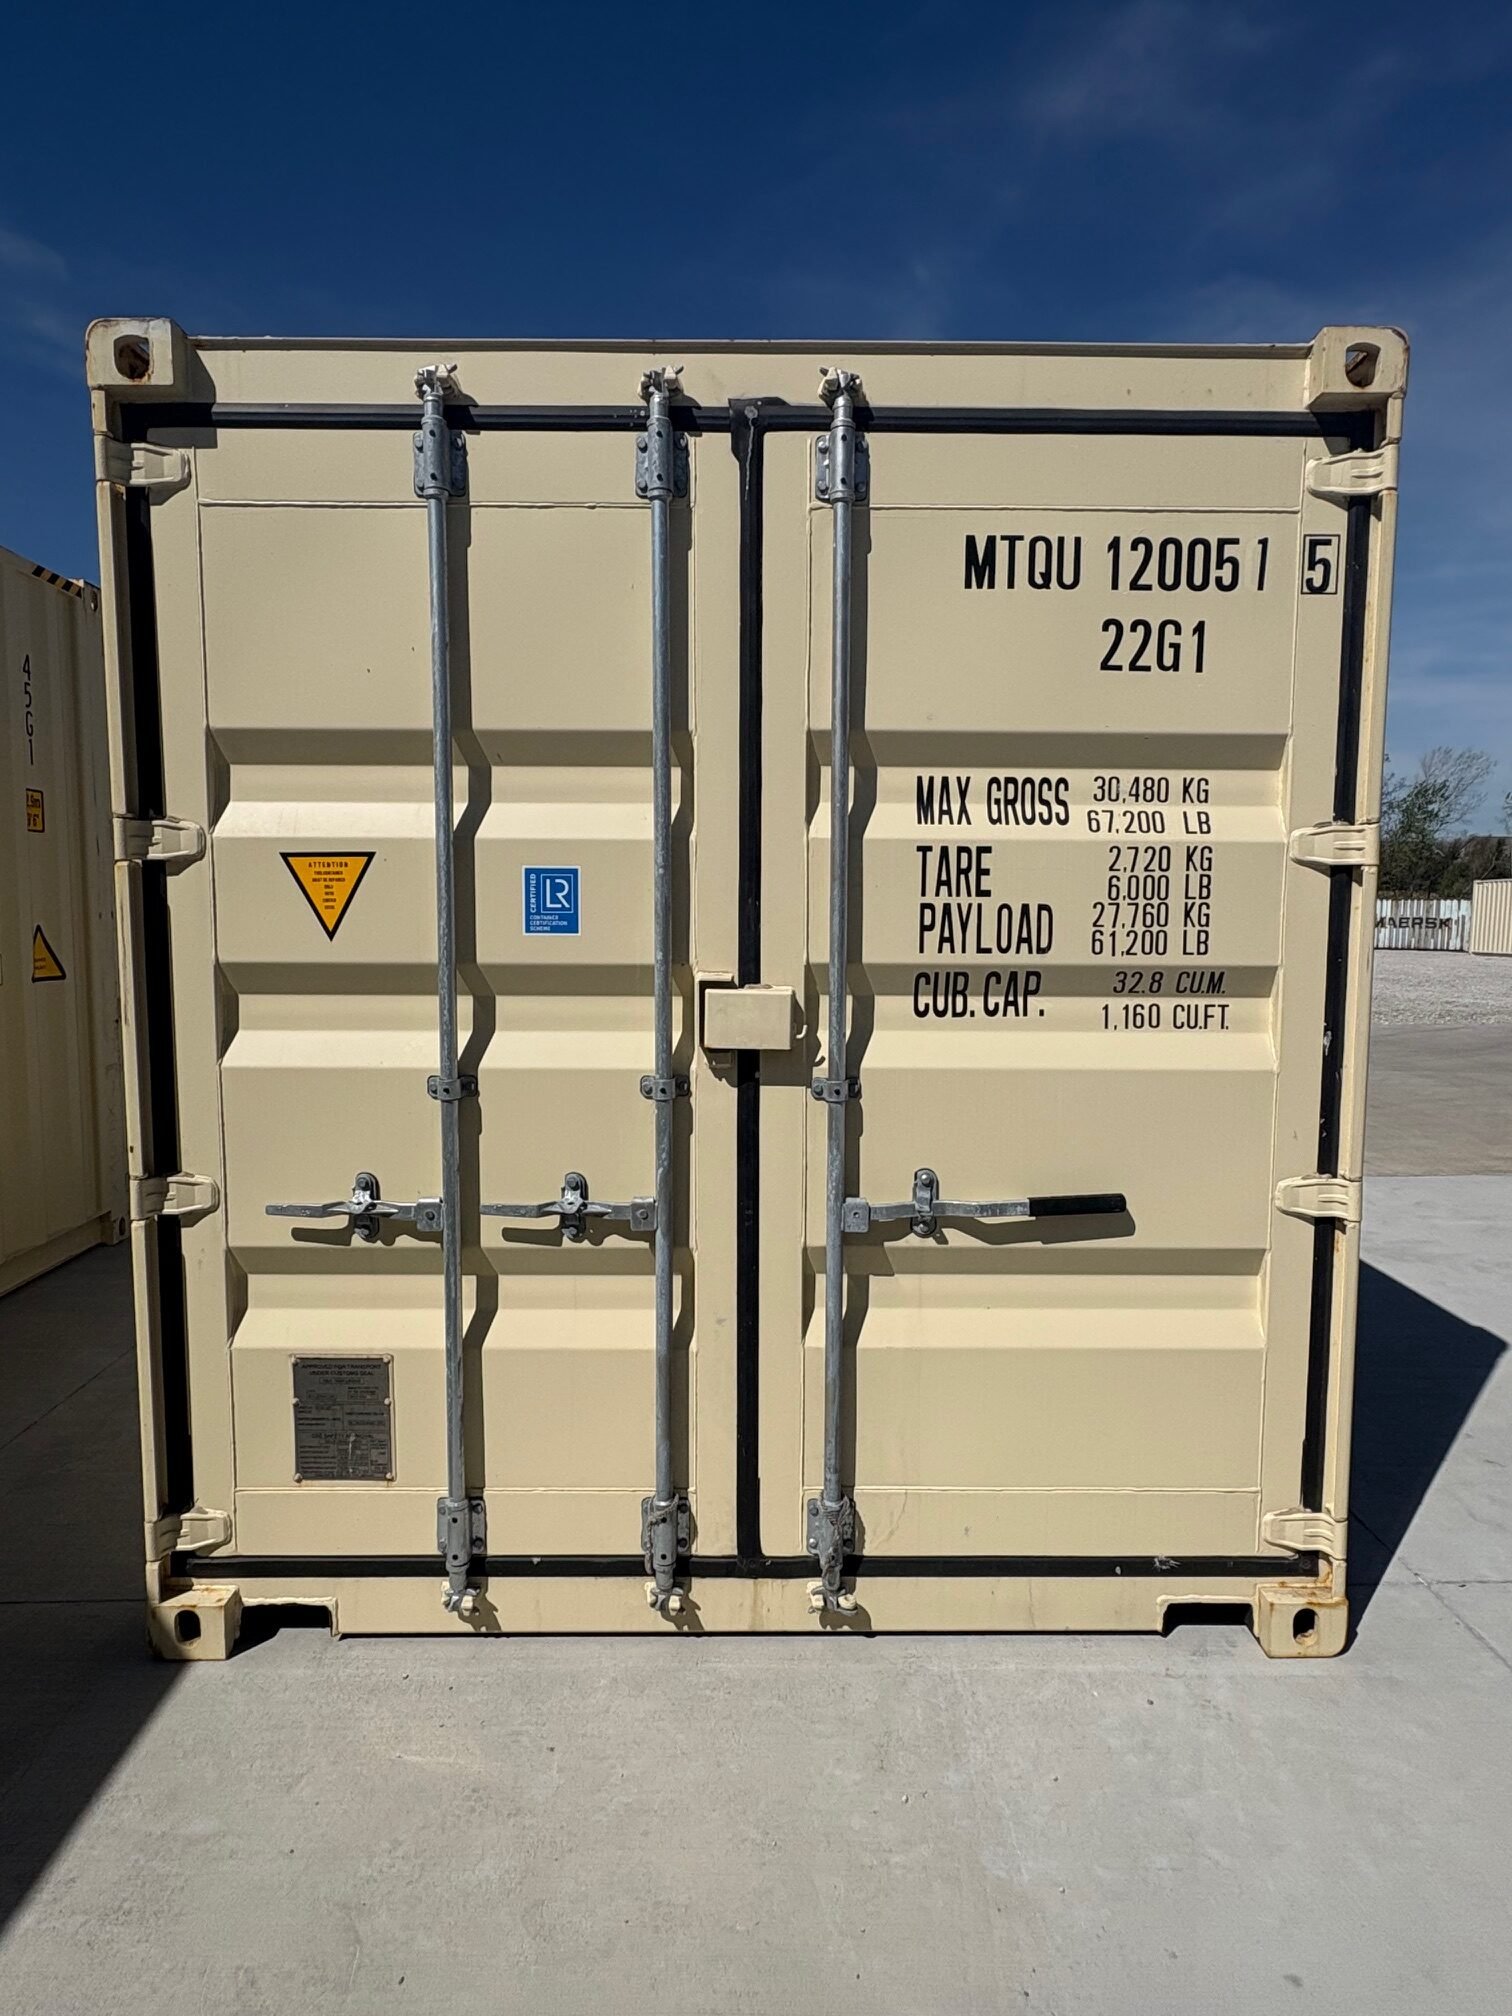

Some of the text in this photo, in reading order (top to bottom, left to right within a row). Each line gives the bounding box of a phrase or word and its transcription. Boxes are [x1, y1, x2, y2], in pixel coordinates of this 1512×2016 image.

[964, 534, 1333, 593] MTQU 120051 5
[1100, 618, 1206, 673] 22G1
[22, 653, 34, 767] 45G1
[916, 775, 1070, 826] MAX GROSS
[1093, 776, 1209, 804] 30,480 KG
[1087, 810, 1211, 834] 67,200 LB
[916, 845, 993, 898] TARE
[1108, 845, 1213, 873] 2,720 KG
[529, 873, 537, 913] CERTIFIED
[545, 878, 570, 908] LR
[1107, 873, 1212, 901] 6,000 LB
[919, 902, 1053, 955] PAYLOAD
[1092, 901, 1210, 929] 27,760 KG
[1091, 929, 1209, 957] 61,200 LB
[1112, 970, 1226, 994] 32.8 CU.M.
[1101, 1003, 1160, 1031] 1,160
